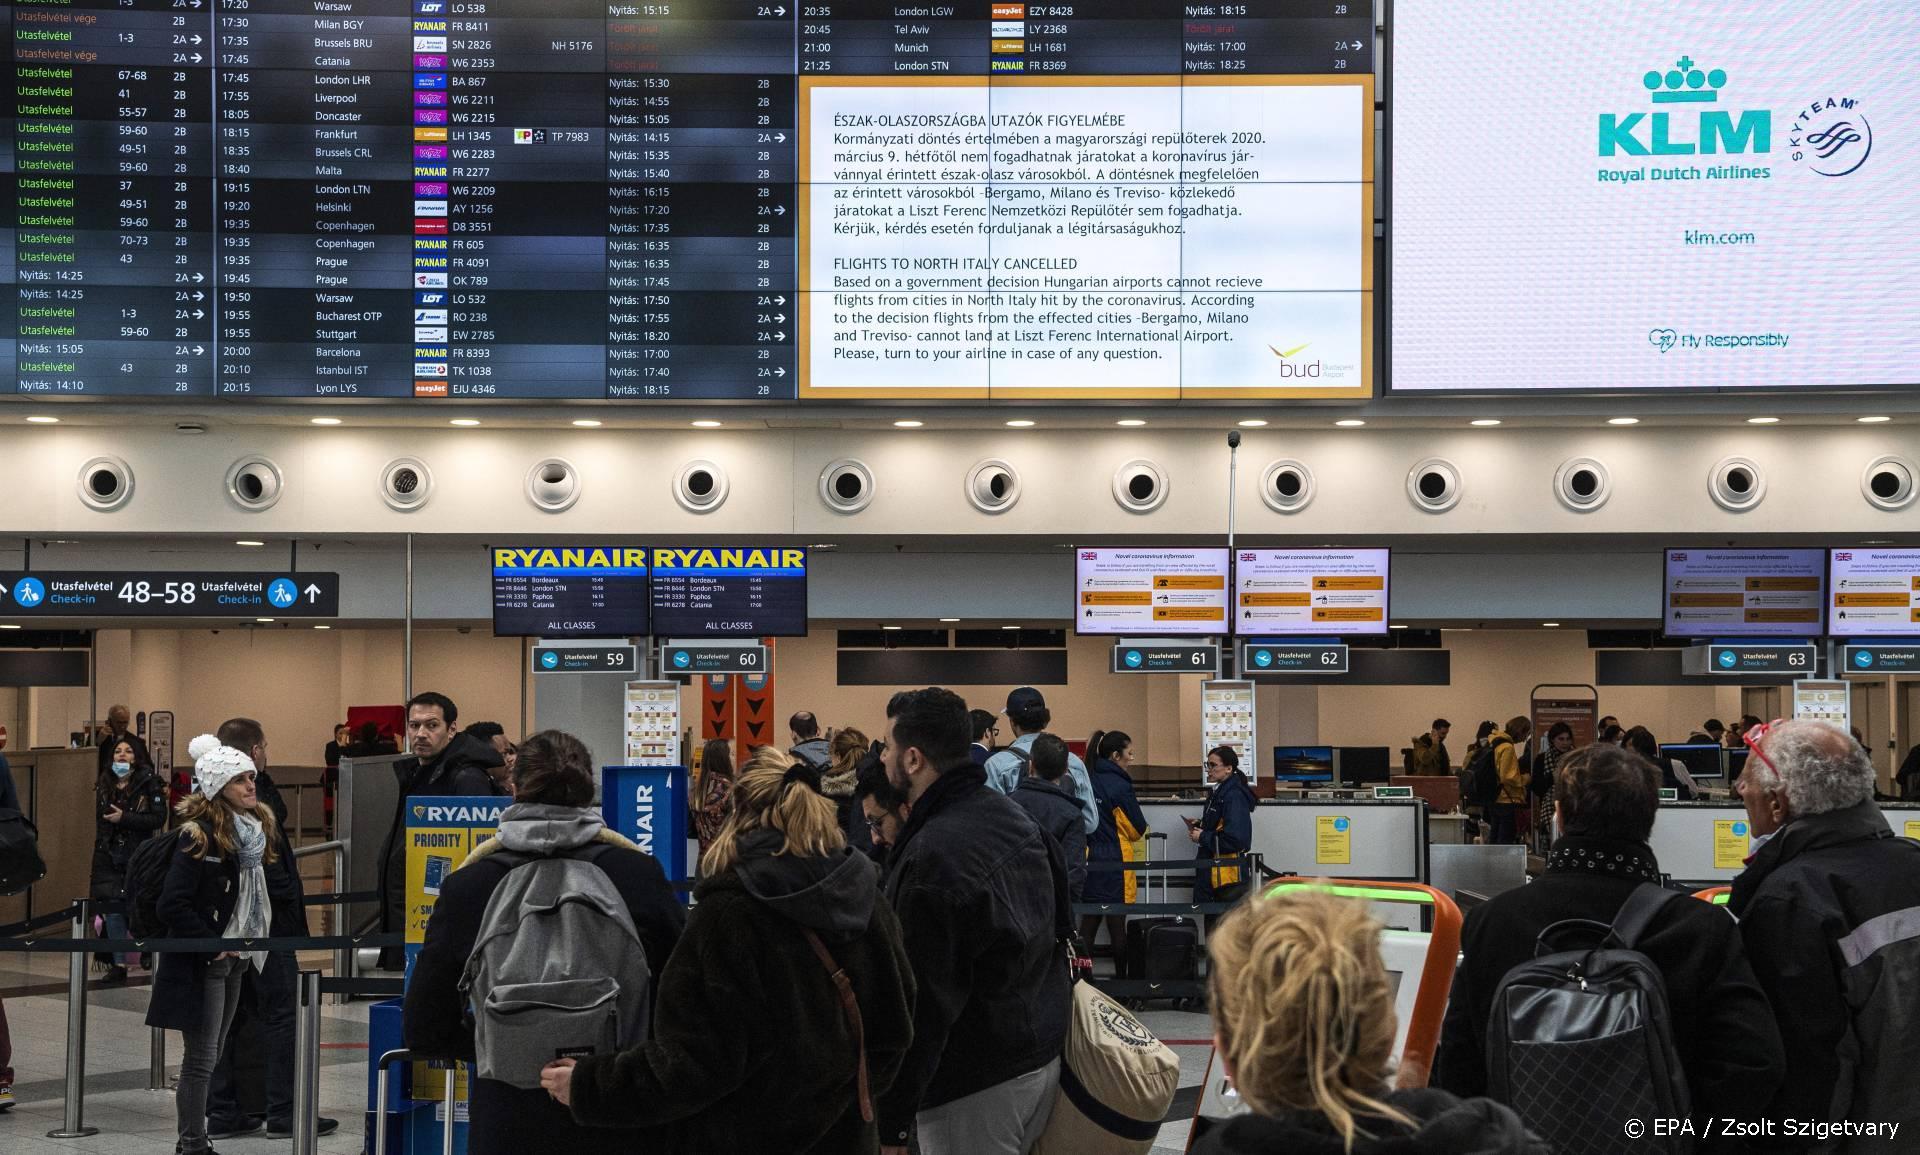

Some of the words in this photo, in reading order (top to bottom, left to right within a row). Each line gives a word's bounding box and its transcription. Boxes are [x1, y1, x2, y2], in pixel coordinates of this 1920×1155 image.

[804, 6, 831, 16] 20:35
[894, 6, 929, 16] London
[931, 6, 954, 16] LGW
[1029, 6, 1047, 16] EZY
[1049, 6, 1074, 16] 8428
[1185, 5, 1216, 18] Nyitás:
[1220, 5, 1246, 15] 18:15
[1335, 4, 1347, 15] 2B
[16, 12, 72, 23] Utasfelvétel
[74, 13, 97, 26] vége
[172, 16, 186, 26] 2B
[992, 61, 1024, 71] RYANAIR
[16, 67, 73, 79] Utasfelvétel
[118, 70, 147, 81] 67-68
[173, 71, 186, 82] 2B
[223, 73, 249, 83] 17:45
[315, 74, 350, 85] London
[352, 75, 371, 85] LHR
[452, 76, 466, 87] BA
[468, 77, 486, 87] 867
[609, 78, 639, 90] Nyitás:
[643, 78, 670, 88] 15:30
[757, 79, 770, 89] 2B
[834, 111, 987, 127] ÉSZAK-OLASZORSZÁGBA
[992, 111, 1044, 127] UTAZÓK
[1047, 111, 1125, 127] FIGYELMÉBE
[223, 127, 250, 138] 18:15
[315, 129, 358, 140] Frankfurt
[452, 131, 465, 141] LH
[468, 131, 491, 141] 1345
[551, 132, 564, 142] TP
[565, 132, 589, 142] 7983
[609, 132, 639, 144] Nyitás:
[644, 132, 670, 143] 14:15
[757, 133, 771, 143] 2A
[1598, 109, 1771, 157] KLM
[1789, 97, 1857, 161] SKYTEAM
[834, 131, 914, 147] Kormányzati
[917, 132, 961, 145] döntés
[964, 131, 1040, 145] értelmében
[1043, 135, 1052, 145] a
[1055, 131, 1147, 148] magyarországi
[1151, 131, 1228, 147] repülőterek
[1231, 132, 1266, 144] 2020.
[1598, 167, 1646, 185] Royal
[1650, 166, 1701, 181] Dutch
[1706, 165, 1771, 180] Airlines
[1684, 229, 1755, 245] klm.com
[834, 257, 887, 270] FLIGHTS
[890, 257, 910, 270] TO
[913, 257, 958, 270] NORTH
[963, 257, 1000, 270] ITALY
[1003, 257, 1078, 270] CANCELLED
[19, 270, 51, 282] Nyitás:
[56, 271, 83, 281] 14:25
[175, 273, 189, 283] 2A
[834, 275, 871, 288] Based
[874, 278, 891, 288] on
[894, 278, 903, 288] a
[906, 276, 983, 290] government
[986, 275, 1040, 288] decision
[1044, 275, 1108, 290] Hungarian
[1112, 275, 1163, 290] airports
[1166, 276, 1211, 288] cannot
[1215, 275, 1263, 288] recieve
[422, 294, 443, 303] LOT
[224, 310, 251, 320] 19:55
[316, 311, 362, 321] Bucharest
[363, 311, 383, 321] OTP
[453, 312, 467, 322] RO
[469, 312, 488, 322] 238
[609, 313, 640, 325] Nyitás:
[644, 313, 670, 323] 17:55
[757, 314, 772, 324] 2A
[1681, 333, 1702, 349] Fly
[1705, 332, 1790, 348] Responsibly
[834, 347, 879, 361] Please,
[884, 348, 911, 359] turn
[915, 348, 929, 359] to
[932, 350, 962, 362] your
[965, 347, 1007, 360] airline
[1010, 347, 1023, 359] in
[1026, 350, 1056, 360] case
[1059, 347, 1073, 359] of
[1076, 350, 1100, 362] any
[1103, 347, 1163, 362] question.
[1280, 359, 1320, 378] bud
[20, 379, 52, 392] Nyitás:
[56, 380, 84, 391] 14:10
[175, 382, 188, 392] 2B
[223, 382, 251, 392] 20:15
[316, 383, 338, 395] Lyon
[340, 383, 358, 393] LYS
[415, 384, 446, 393] easyJet
[453, 384, 469, 394] EJU
[471, 384, 496, 394] 4346
[609, 384, 640, 397] Nyitás:
[644, 385, 670, 395] 18:15
[757, 385, 770, 395] 2B
[494, 548, 646, 568] RYANAIR
[653, 549, 804, 568] RYANAIR
[51, 581, 113, 592] Utasfelvétel
[201, 581, 263, 592] Utasfelvétel
[50, 594, 96, 605] Check-in
[217, 594, 262, 605] Check-in
[547, 622, 561, 630] ALL
[563, 621, 596, 630] CLASSES
[705, 622, 719, 630] ALL
[721, 622, 753, 630] CLASSES
[607, 653, 624, 666] 59
[739, 653, 756, 666] 60
[1191, 652, 1206, 665] 61
[1321, 652, 1338, 665] 62
[1788, 652, 1806, 666] 63
[427, 806, 501, 822] RYANA
[637, 784, 653, 856] NAIR
[414, 833, 461, 848] PRIORITY
